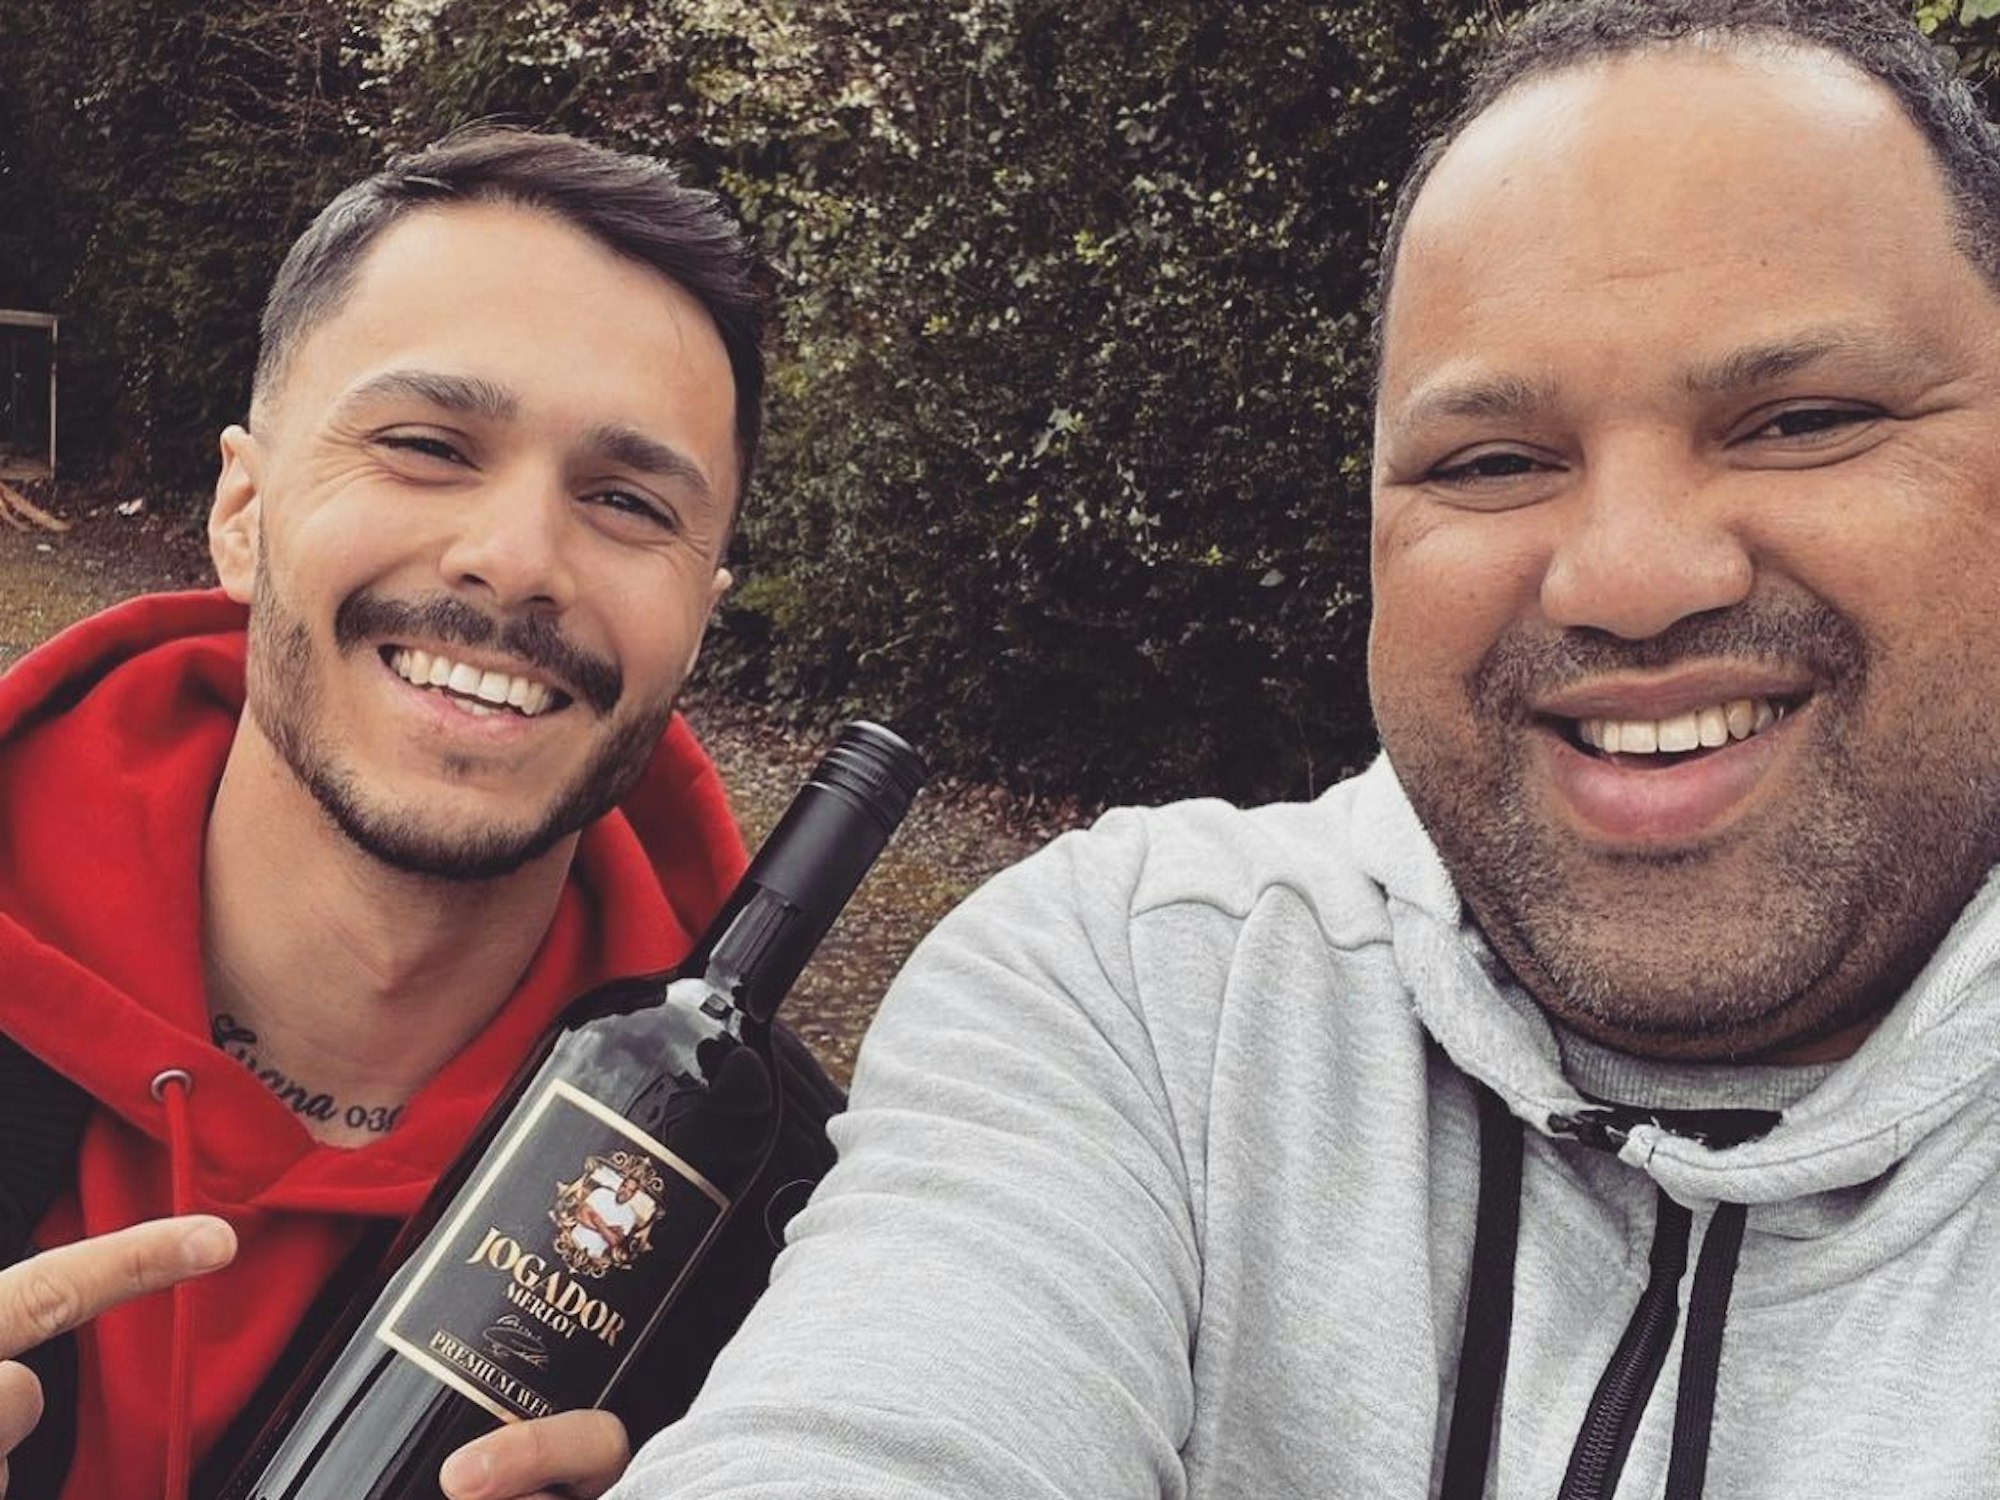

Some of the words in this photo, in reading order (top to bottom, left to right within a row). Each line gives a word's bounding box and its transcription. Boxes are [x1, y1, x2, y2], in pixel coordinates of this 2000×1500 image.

[465, 1226, 626, 1347] JOGADOR
[503, 1281, 579, 1339] MERLOT
[428, 1330, 516, 1396] PREMIUM
